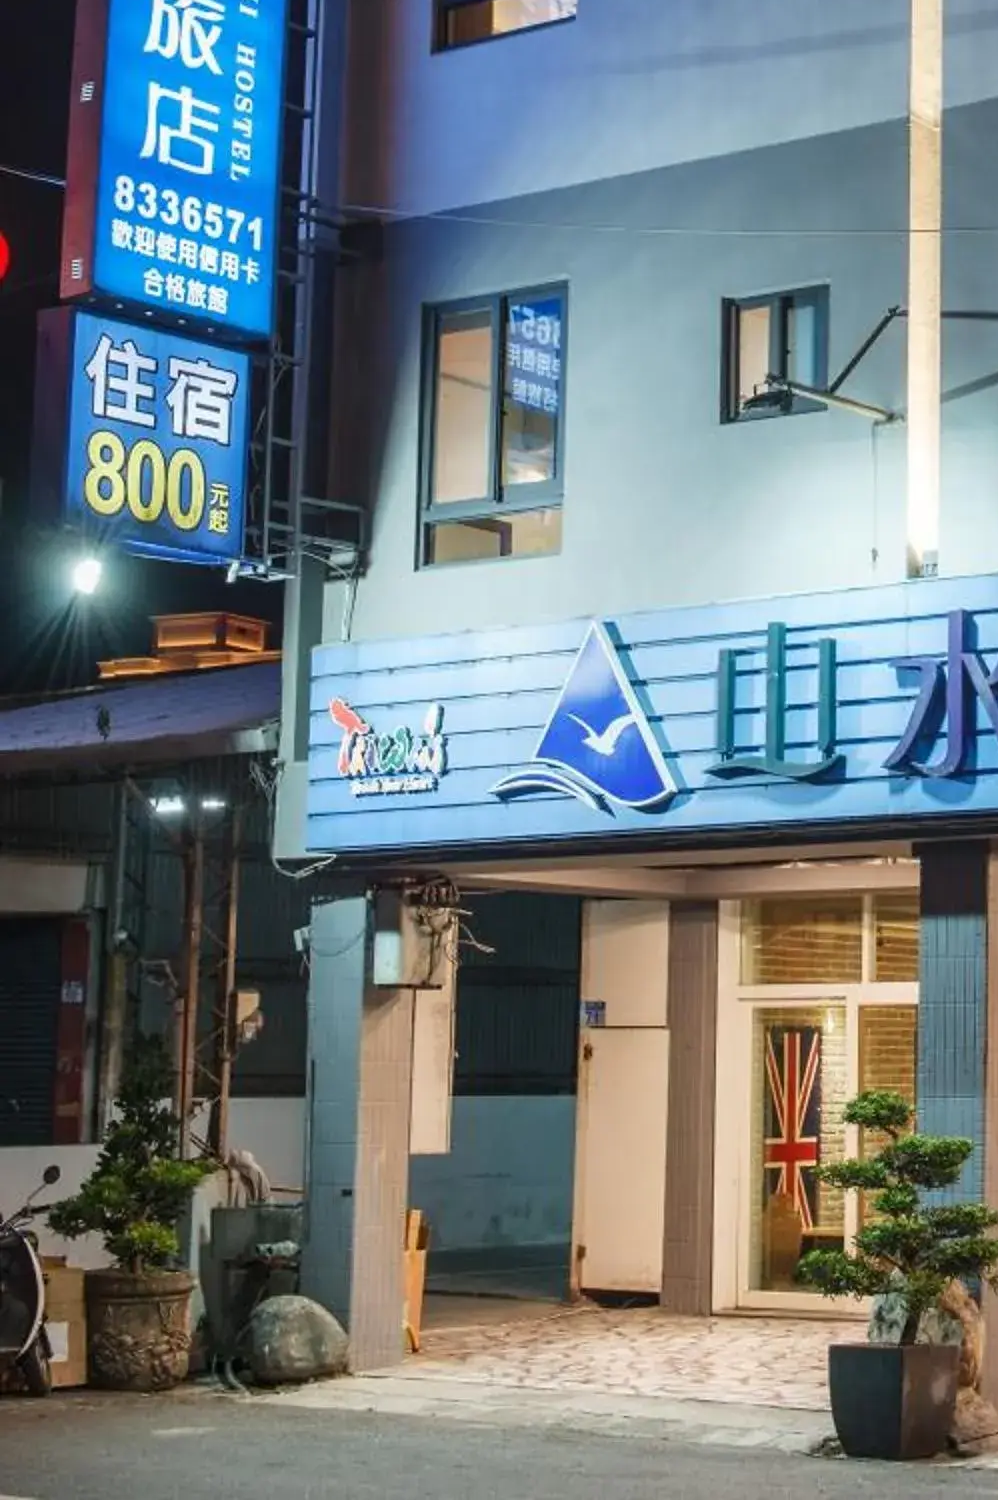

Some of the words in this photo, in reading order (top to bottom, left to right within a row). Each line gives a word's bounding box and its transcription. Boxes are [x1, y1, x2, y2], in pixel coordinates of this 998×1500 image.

[229, 41, 257, 182] HOSTEL
[111, 218, 261, 285] 歡迎使用信用卡
[114, 175, 263, 251] 8336571
[143, 267, 229, 315] 合格旅館
[84, 332, 239, 447] 住宿
[84, 429, 206, 532] 800
